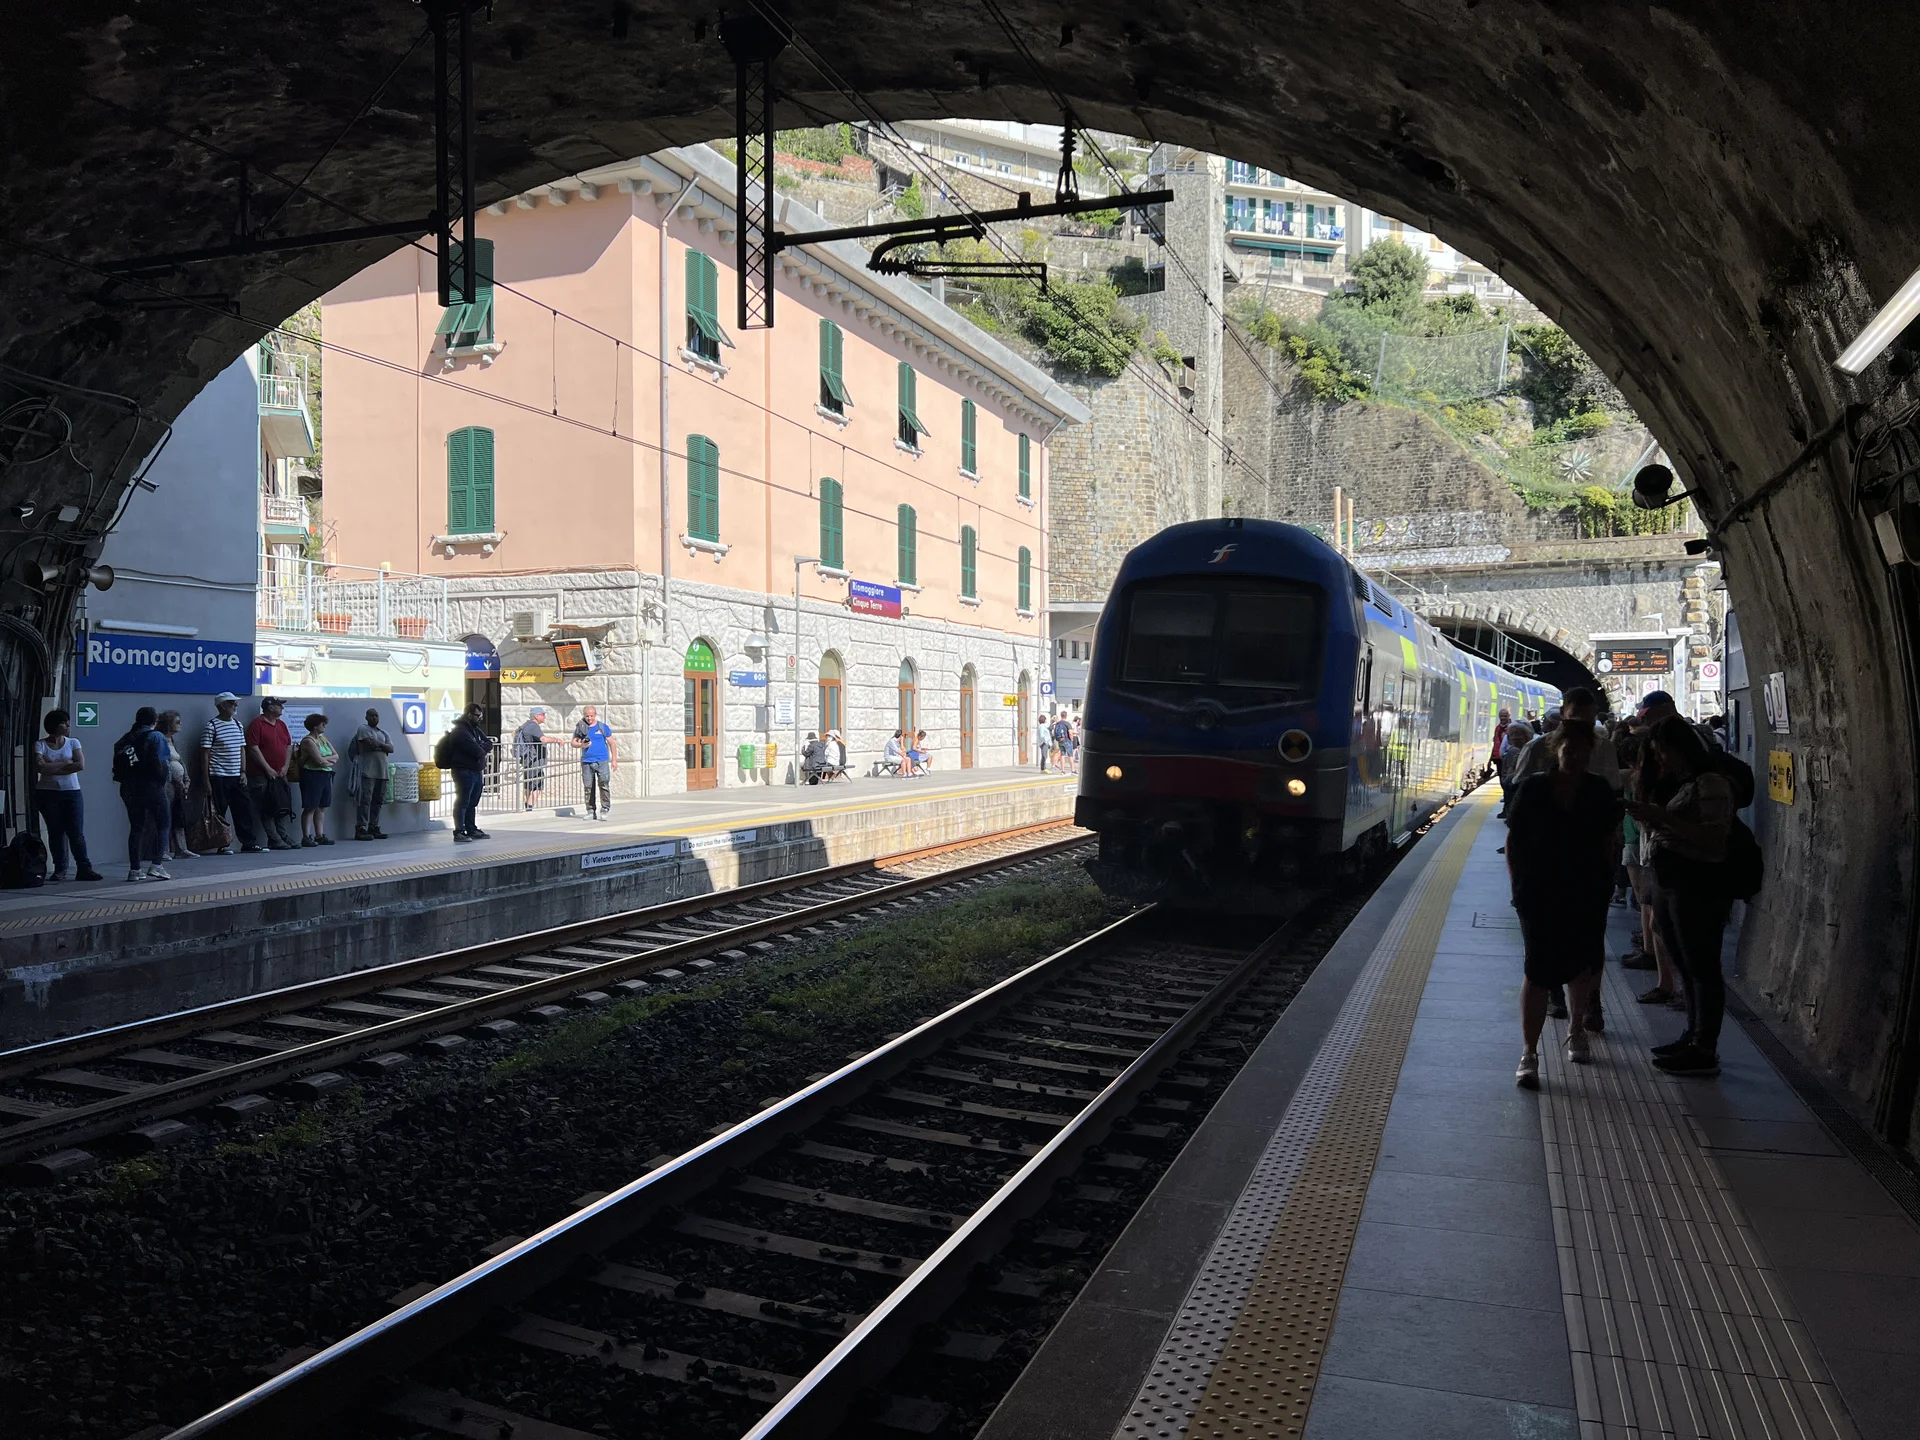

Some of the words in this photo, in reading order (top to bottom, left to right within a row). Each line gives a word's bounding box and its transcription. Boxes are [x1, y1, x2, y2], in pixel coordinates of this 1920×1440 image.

[853, 582, 884, 596] Riomaggiore
[853, 597, 869, 610] Cinque
[870, 600, 883, 611] Terre
[88, 640, 240, 674] Riomaggiore
[491, 648, 498, 657] 2
[411, 709, 419, 724] 1
[592, 855, 612, 864] Vietato
[612, 852, 642, 861] attraversare
[645, 848, 659, 856] binari
